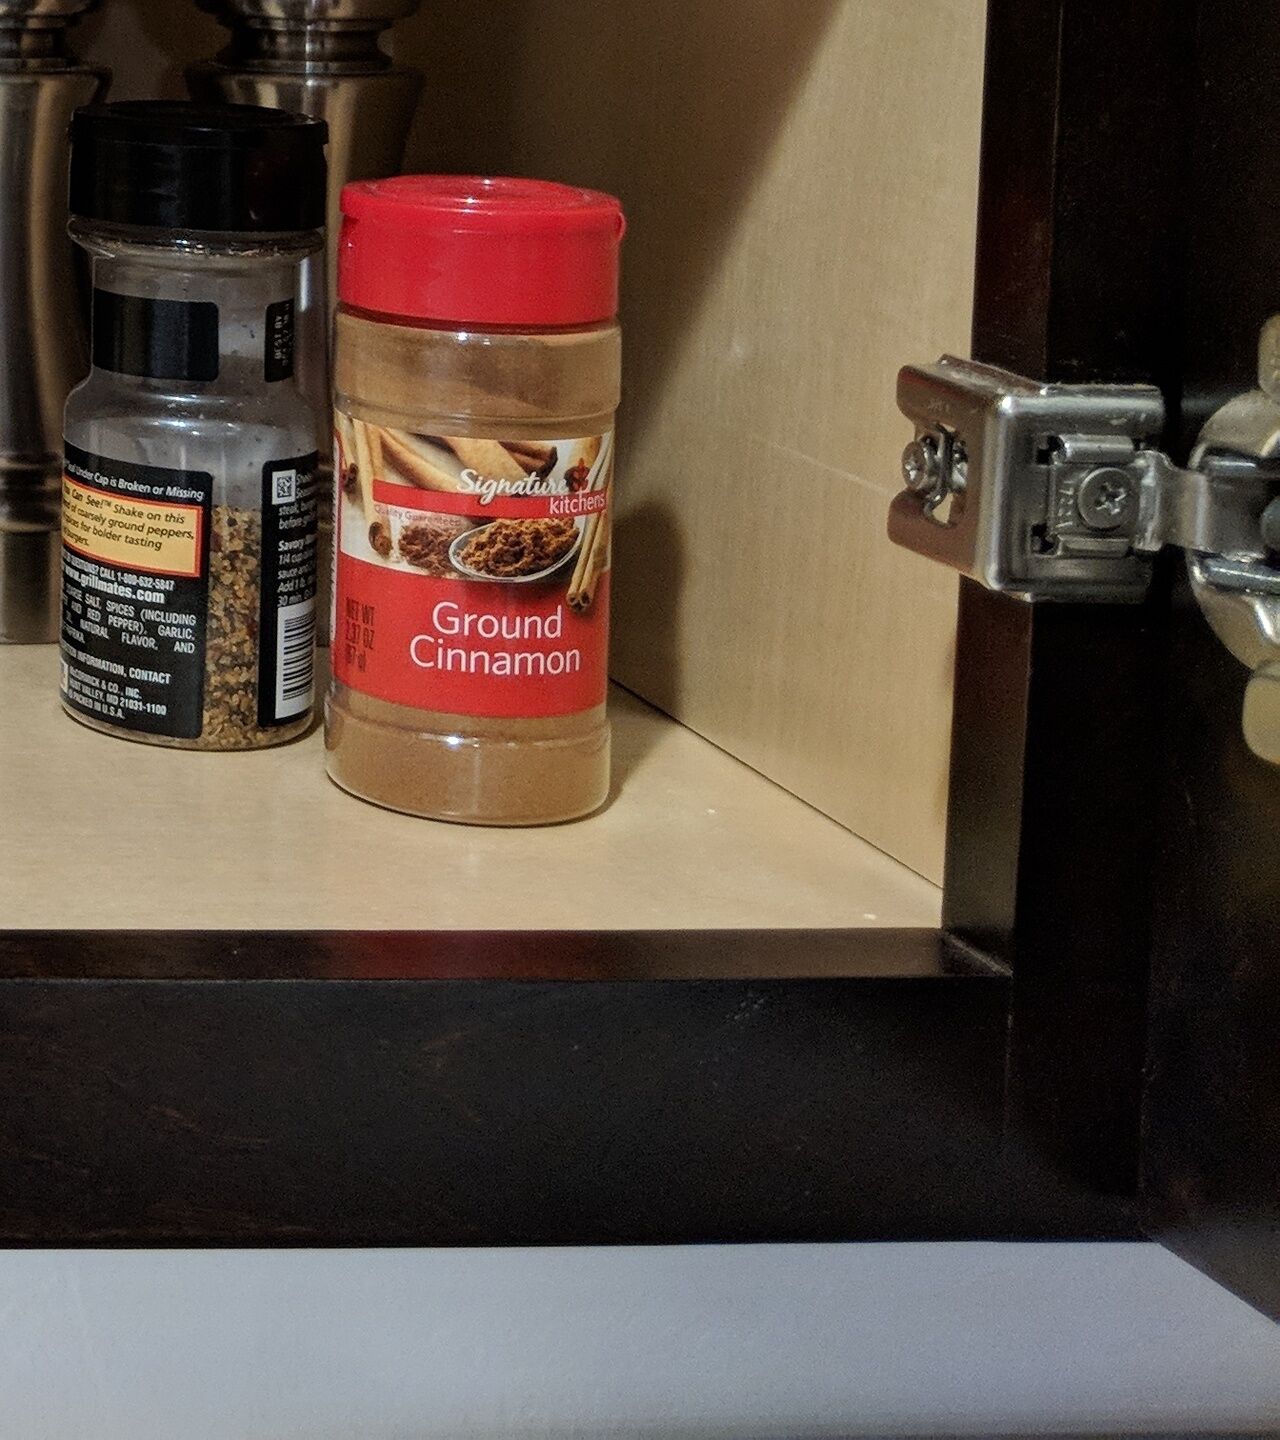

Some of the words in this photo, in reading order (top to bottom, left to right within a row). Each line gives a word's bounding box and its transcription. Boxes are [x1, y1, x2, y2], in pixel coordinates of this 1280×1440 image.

[117, 478, 152, 494] Broken
[152, 485, 164, 496] or
[165, 485, 205, 502] Missing
[456, 468, 568, 506] Signature
[112, 504, 145, 520] Shake
[146, 511, 162, 522] on
[164, 512, 186, 525] this
[549, 489, 605, 515] kitchens
[92, 525, 122, 542] bolder
[124, 534, 163, 552] tasting
[107, 518, 146, 533] ground
[105, 599, 136, 618] SPICES
[140, 608, 197, 627] (INCLUDING
[431, 601, 563, 640] Ground
[173, 641, 196, 654] AND
[409, 634, 581, 675] Cinnamon
[128, 667, 172, 685] CONTACT
